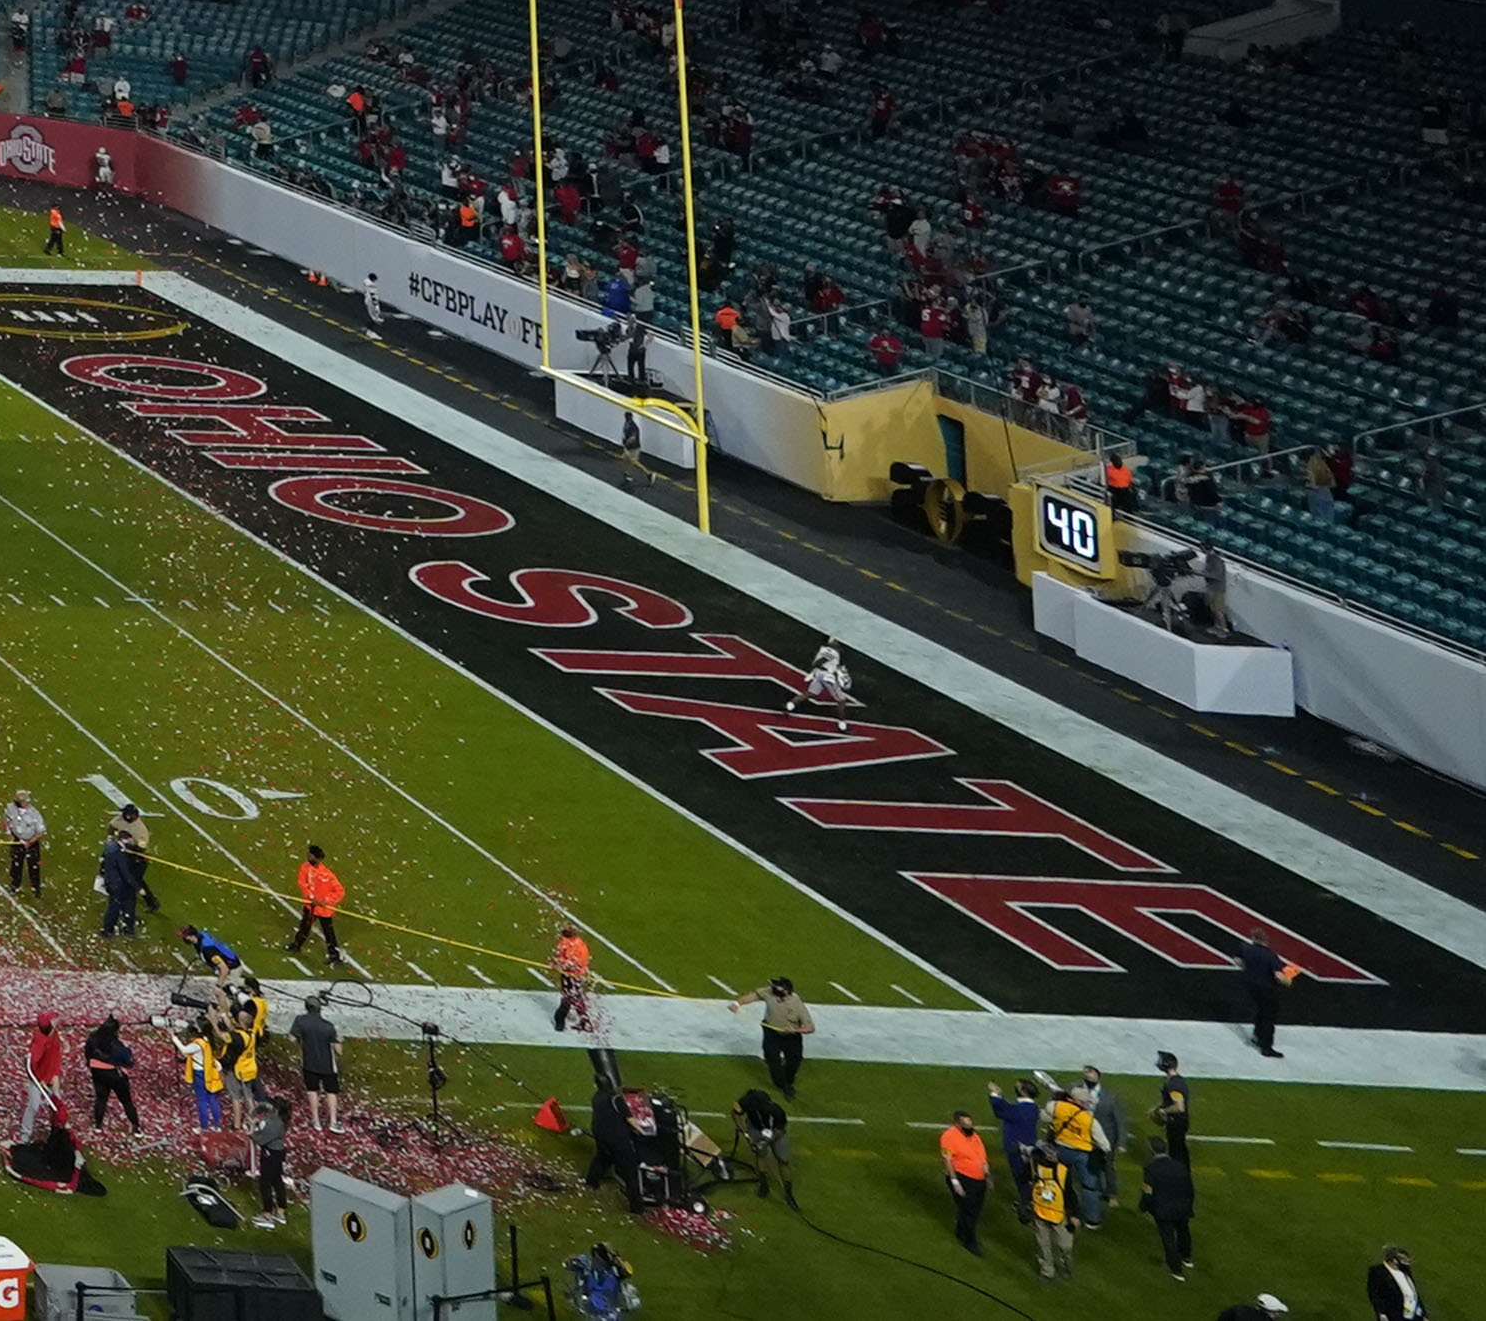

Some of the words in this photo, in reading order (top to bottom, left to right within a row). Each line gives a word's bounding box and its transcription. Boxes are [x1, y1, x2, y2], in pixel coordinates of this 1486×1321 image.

[59, 353, 516, 538] OHIO
[1046, 501, 1096, 560] 40
[78, 772, 261, 822] 10
[407, 560, 1390, 986] STATE
